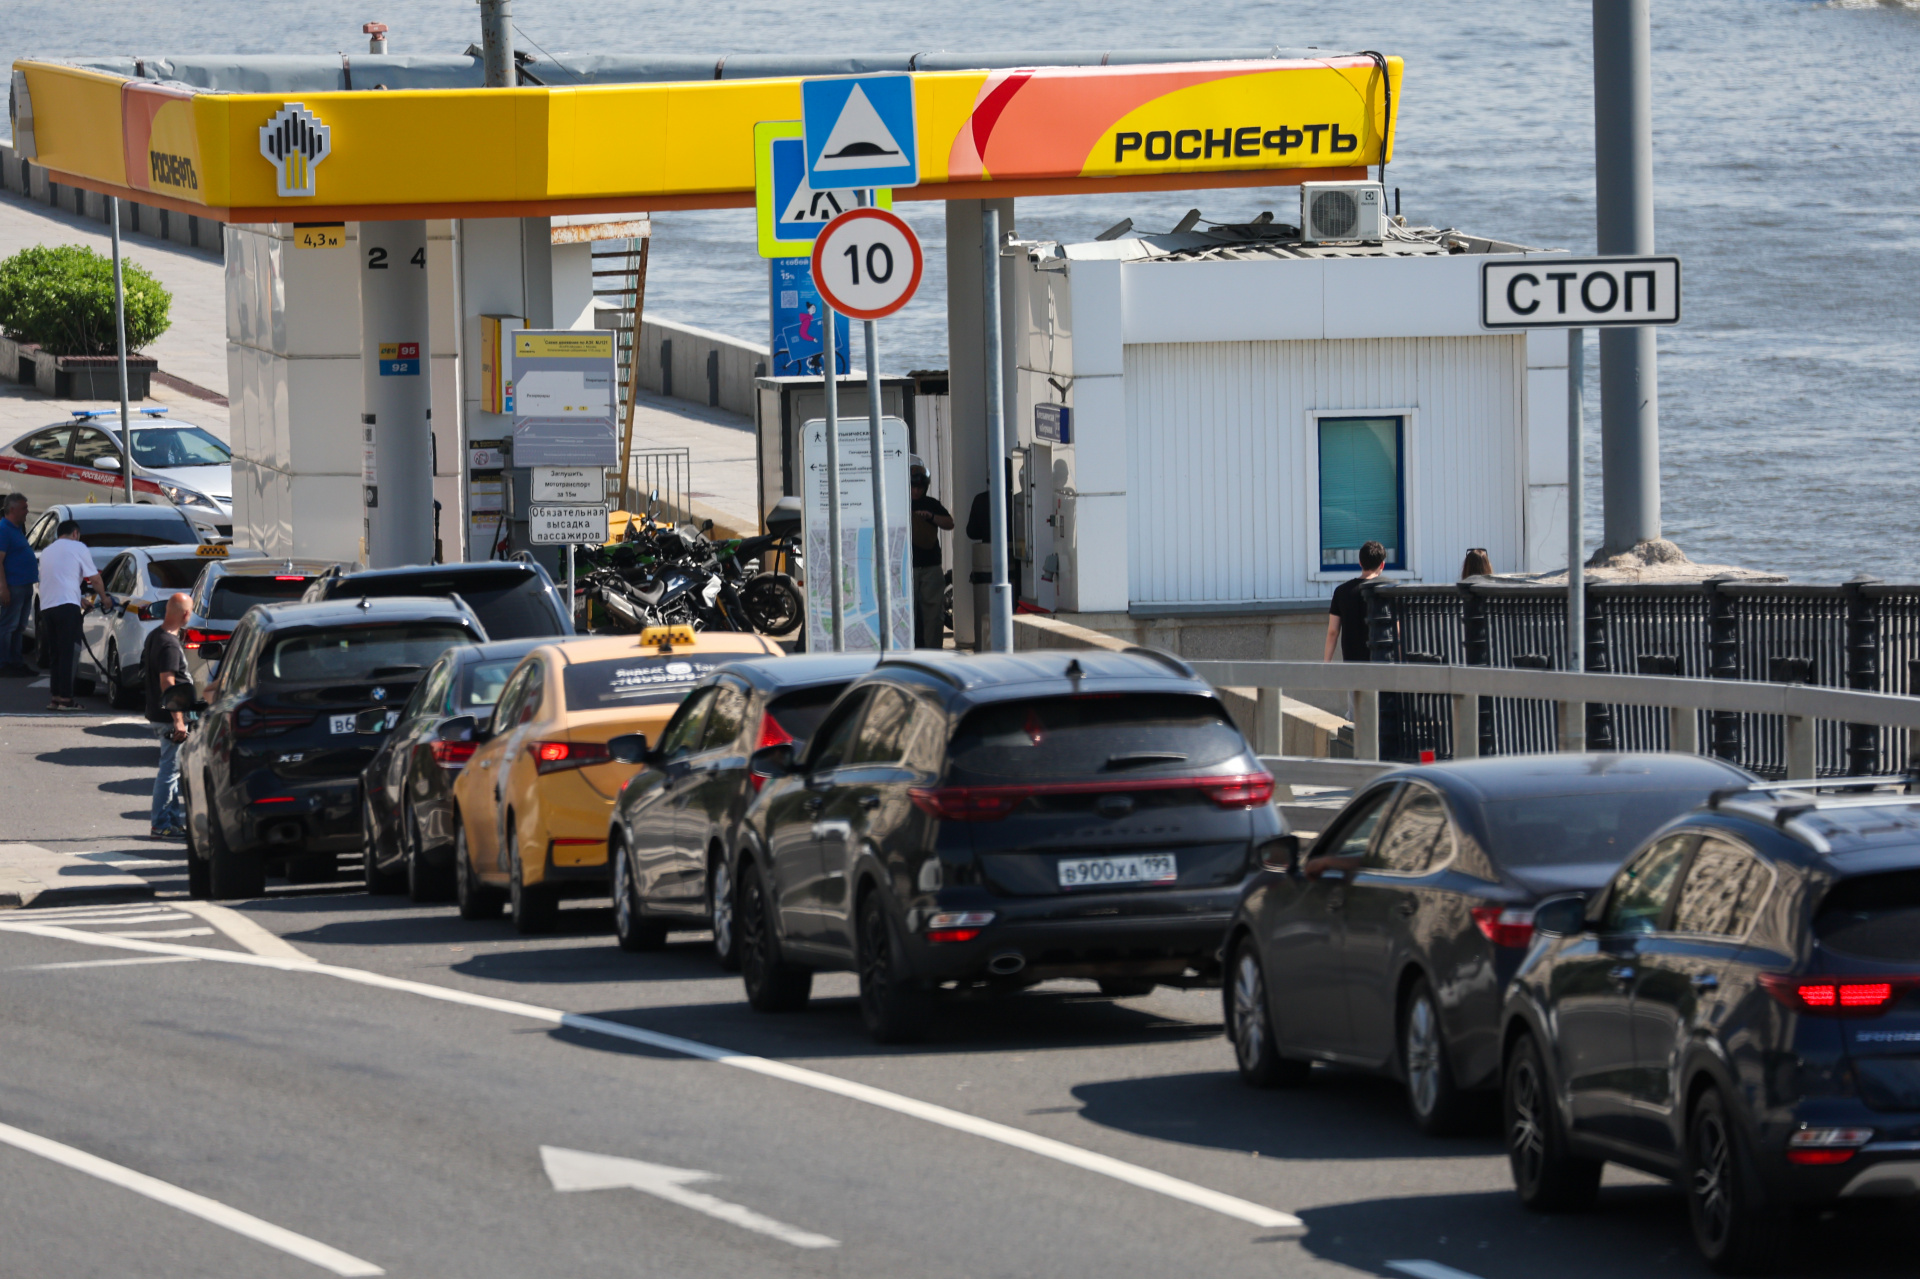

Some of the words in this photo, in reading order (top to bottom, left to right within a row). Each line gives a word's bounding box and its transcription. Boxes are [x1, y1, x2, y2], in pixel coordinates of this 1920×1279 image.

[1115, 123, 1358, 162] РОСНЕФТЬ
[151, 150, 197, 189] РОСНЕФТЬ
[304, 233, 326, 248] 4,3
[368, 247, 388, 269] 2
[410, 247, 426, 269] 4
[843, 242, 894, 285] 10
[1507, 270, 1656, 316] СТОП
[401, 347, 416, 355] 95
[392, 364, 408, 372] 92
[532, 507, 604, 517] Обязательная
[547, 520, 590, 529] высадка
[538, 532, 600, 541] пассажиров
[1065, 862, 1141, 883] В900ХА
[1144, 857, 1170, 871] 199
